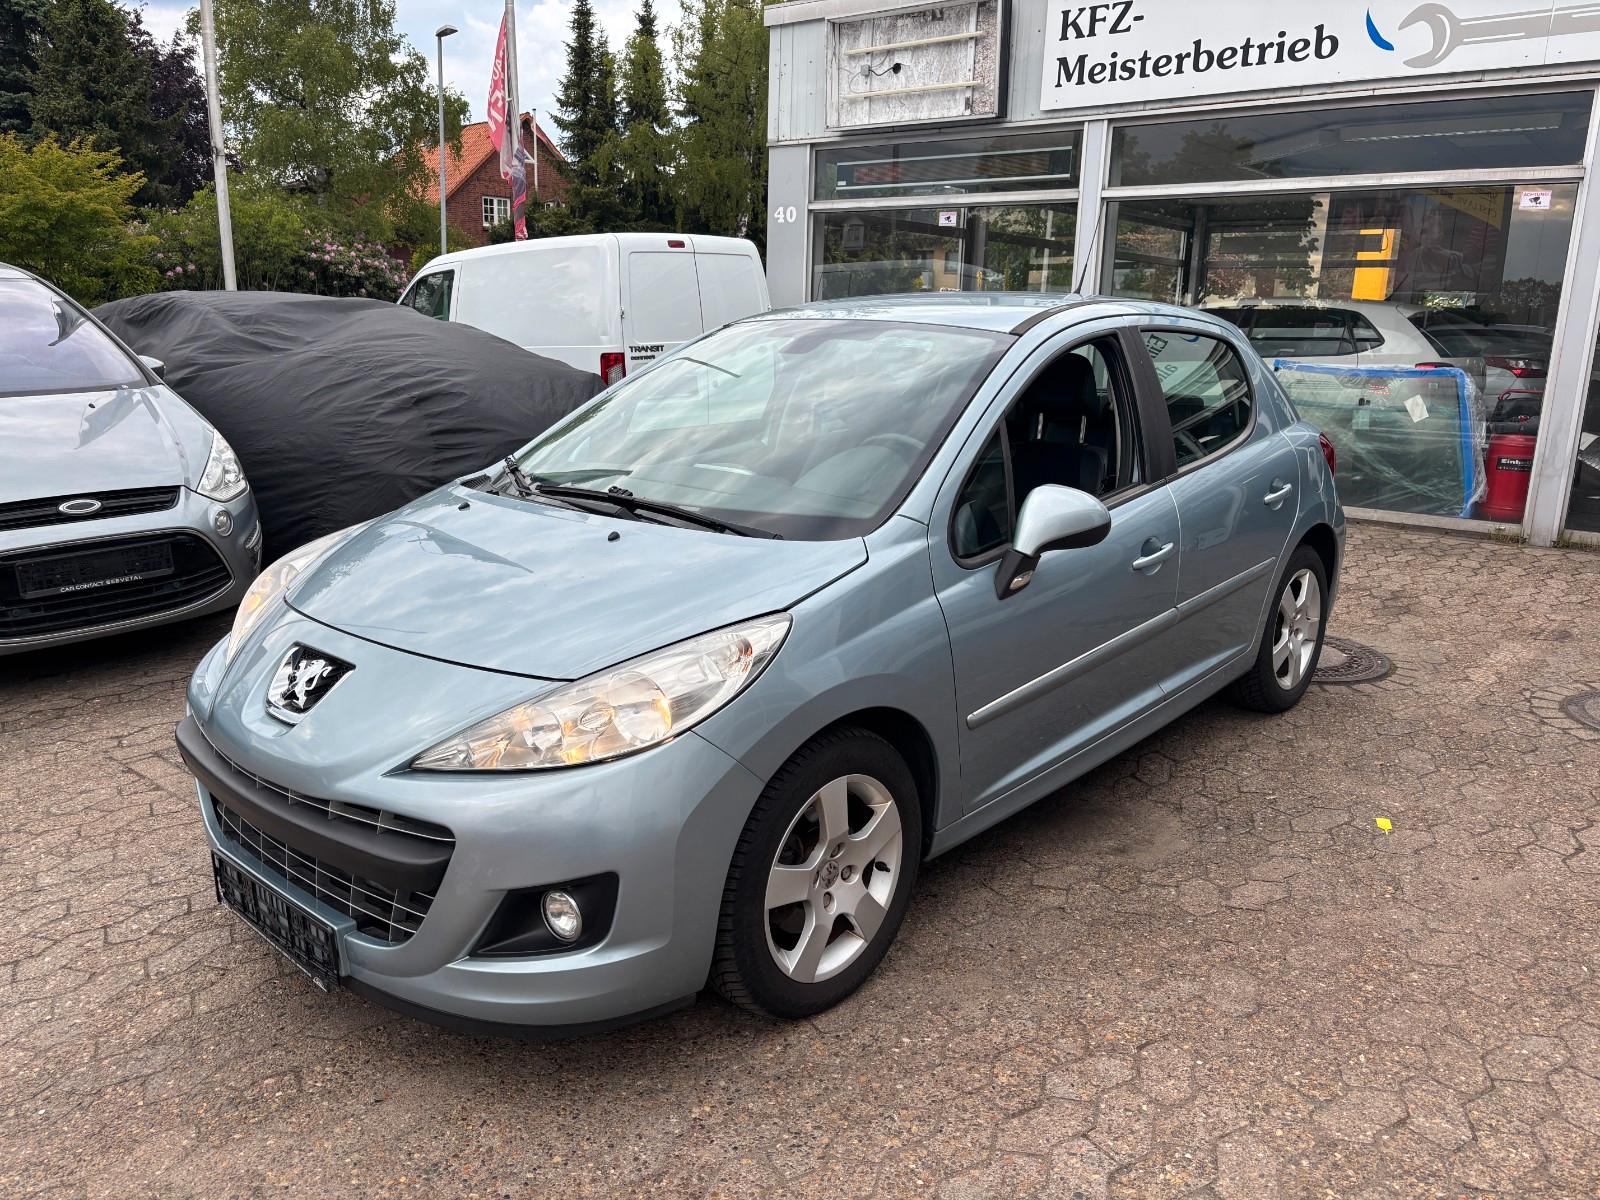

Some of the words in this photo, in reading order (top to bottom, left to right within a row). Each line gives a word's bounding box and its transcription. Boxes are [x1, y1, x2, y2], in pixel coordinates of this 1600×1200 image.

[1059, 0, 1145, 41] KFZ-
[1055, 24, 1339, 88] Meisterbetrieb
[774, 206, 796, 223] 40
[629, 345, 664, 353] TRANSIT
